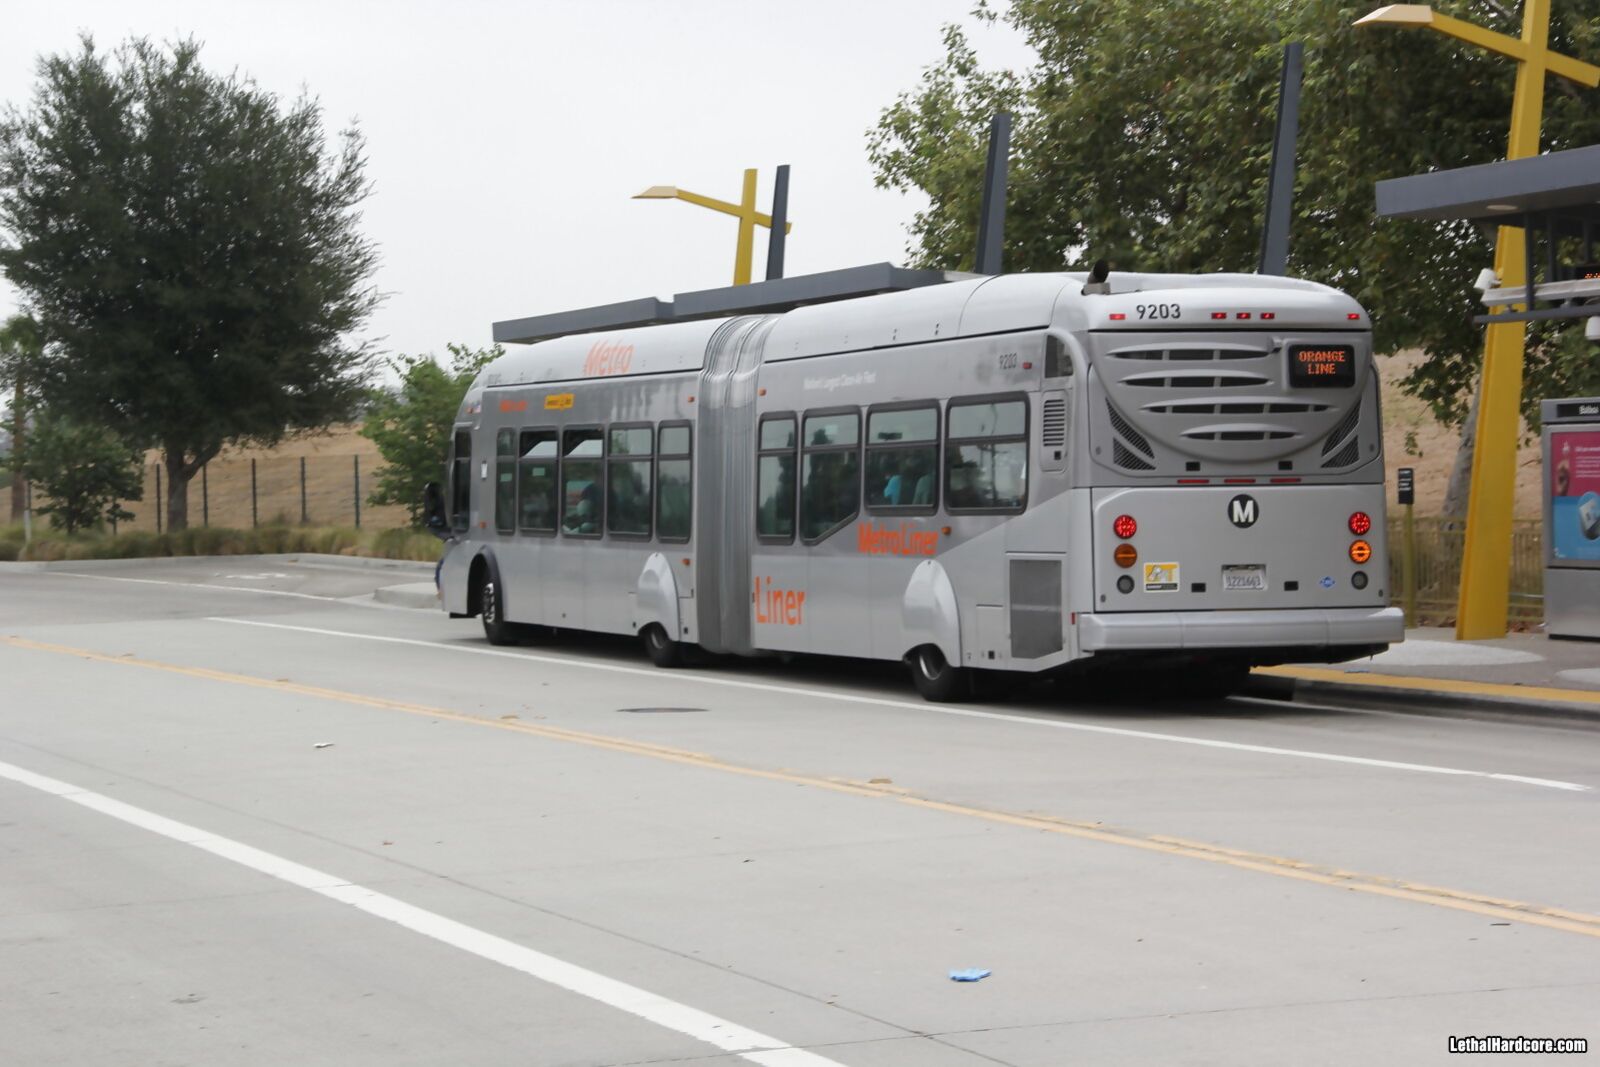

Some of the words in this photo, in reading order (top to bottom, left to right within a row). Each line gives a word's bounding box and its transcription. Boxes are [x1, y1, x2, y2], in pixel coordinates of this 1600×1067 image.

[1135, 303, 1182, 320] 9203
[582, 340, 634, 377] Metro
[1298, 350, 1346, 362] ORANGE
[1307, 363, 1336, 375] LINE
[1232, 500, 1255, 524] M
[857, 522, 939, 556] MetroLiner
[754, 575, 805, 625] Liner
